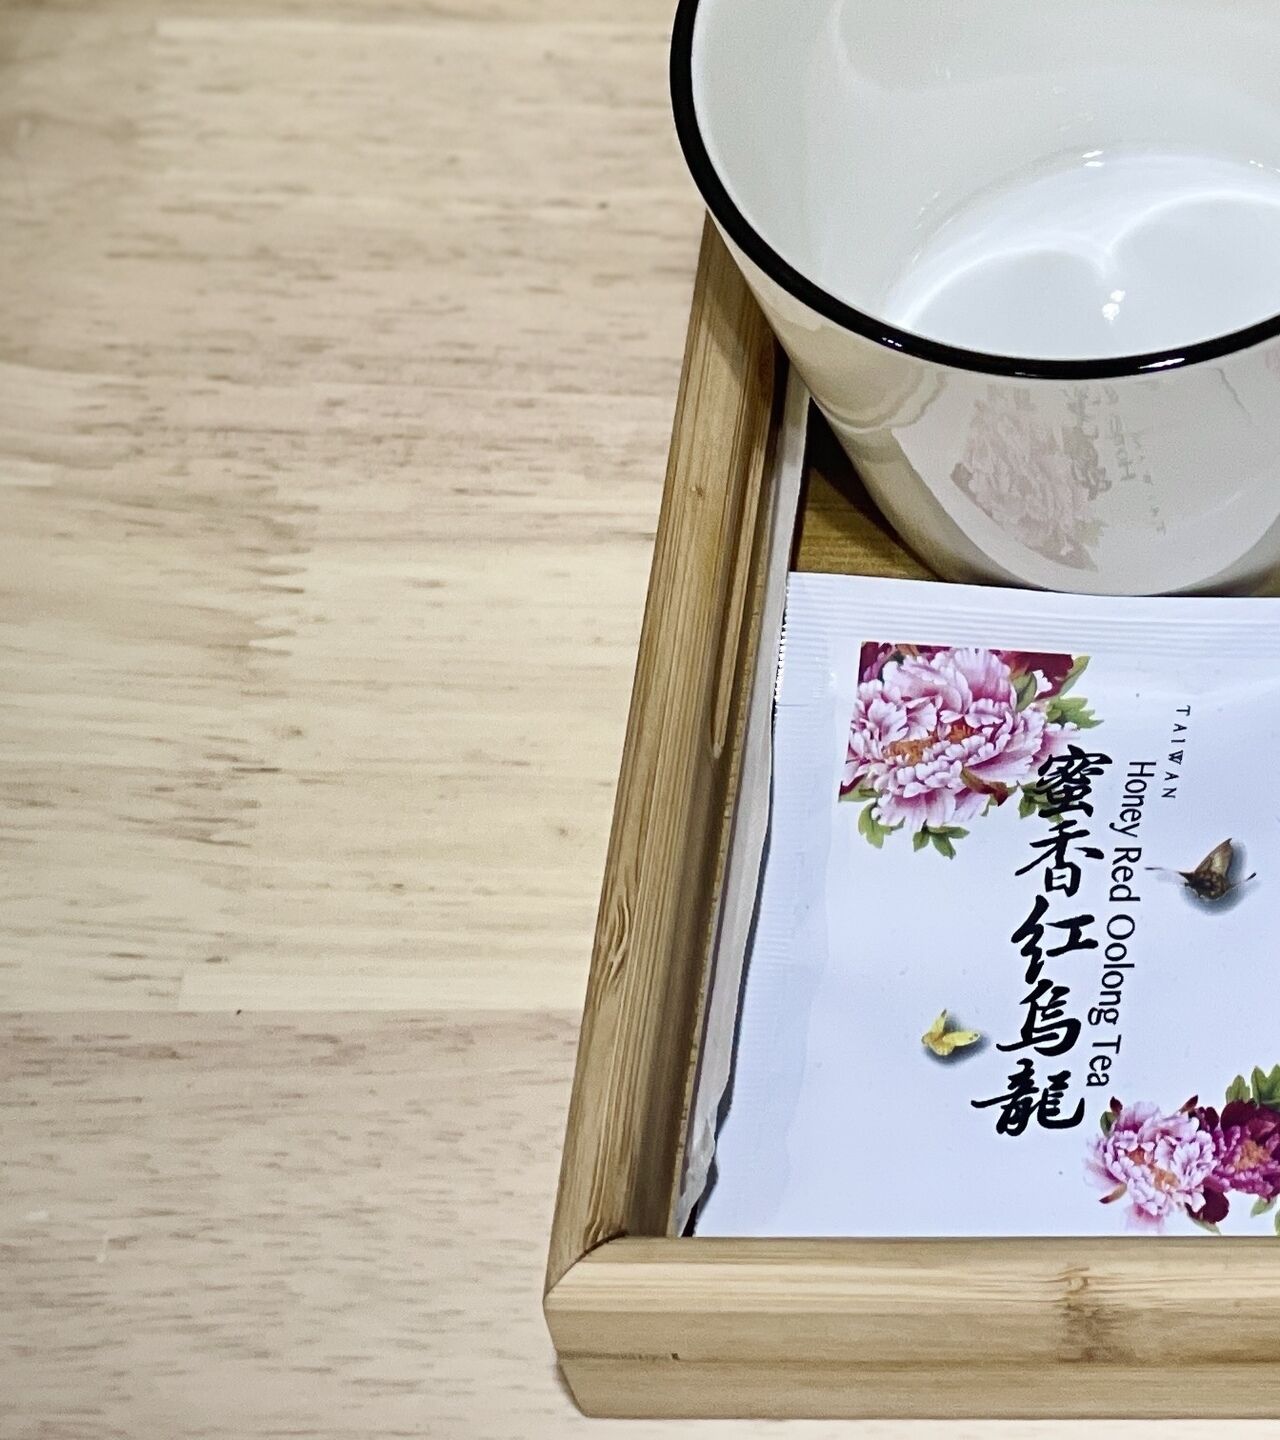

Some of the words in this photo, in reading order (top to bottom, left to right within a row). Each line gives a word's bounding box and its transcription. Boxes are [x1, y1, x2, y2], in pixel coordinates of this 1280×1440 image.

[1161, 704, 1192, 800] TAIWAN
[1109, 760, 1157, 839] Honey
[1106, 846, 1142, 902] Red
[1086, 914, 1138, 1027] Oolong
[1085, 1035, 1123, 1089] Tea
